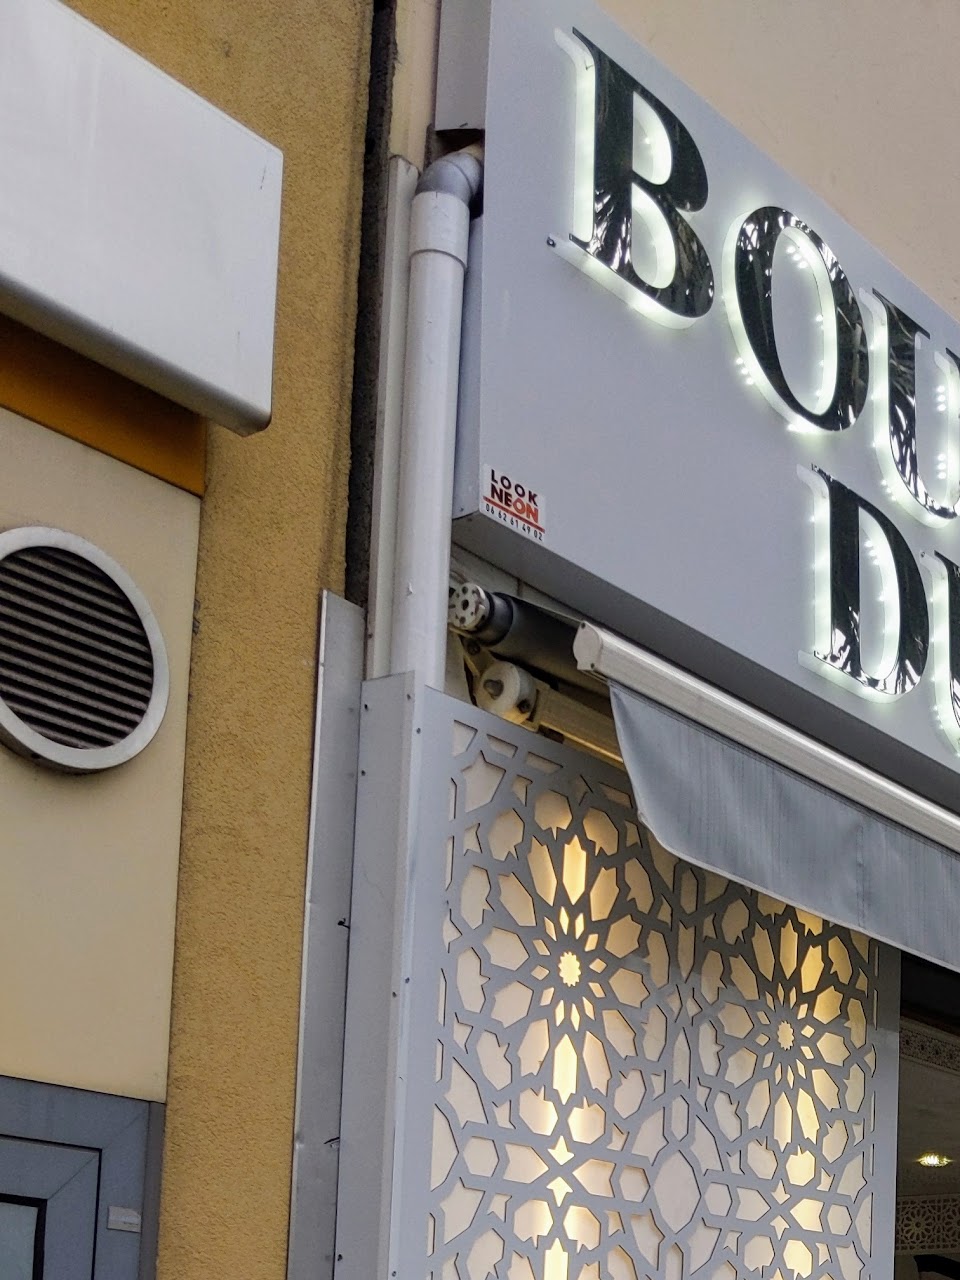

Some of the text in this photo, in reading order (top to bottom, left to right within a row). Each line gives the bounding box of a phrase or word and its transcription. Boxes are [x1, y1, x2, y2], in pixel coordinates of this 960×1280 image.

[490, 482, 539, 524] NEON
[491, 468, 539, 507] LOOK
[485, 503, 543, 542] 06 62 61 49 02
